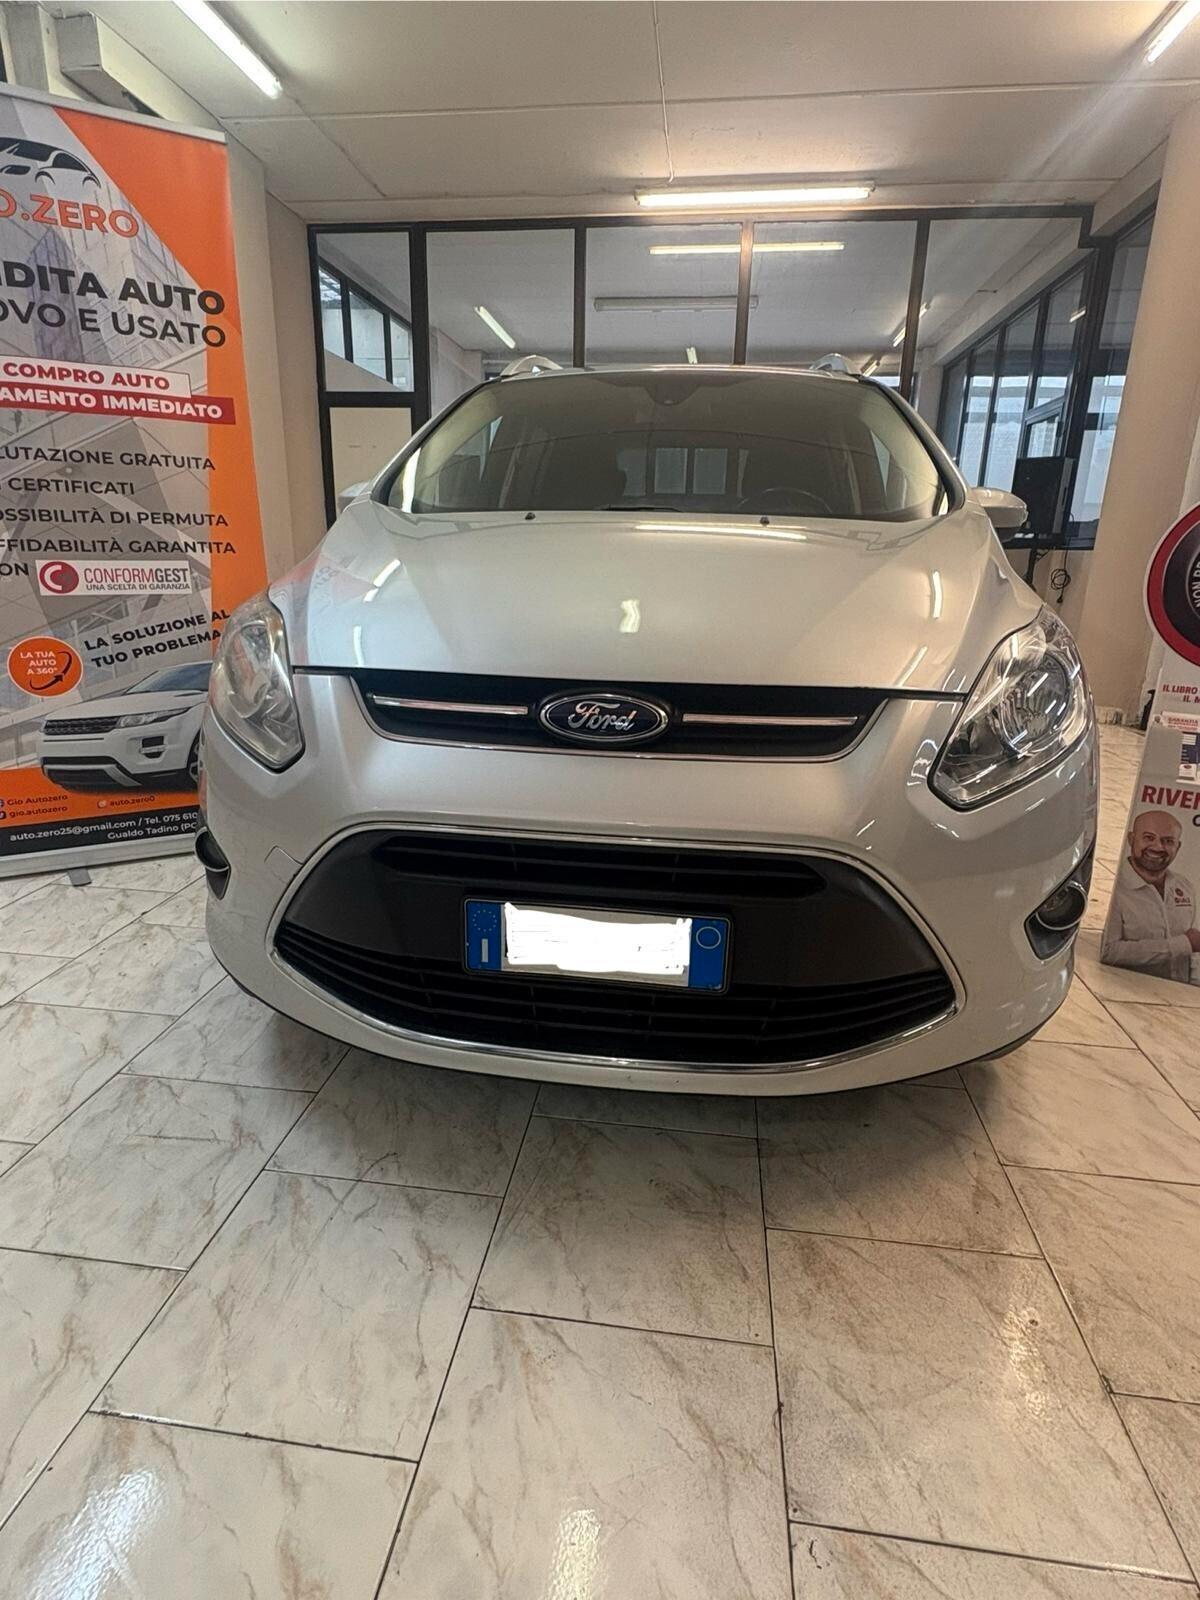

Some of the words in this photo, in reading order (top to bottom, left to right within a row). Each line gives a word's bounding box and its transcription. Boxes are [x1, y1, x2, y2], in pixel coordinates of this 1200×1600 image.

[0, 261, 108, 299] DITA
[118, 278, 225, 315] AUTO
[79, 308, 100, 332] E
[112, 312, 226, 347] USATO
[3, 362, 104, 384] COMPRO
[111, 372, 170, 390] AUTO
[0, 386, 96, 408] AMENTO
[103, 395, 223, 419] IMMEDIATO
[120, 452, 216, 470] GRATUITA
[8, 477, 135, 495] CERTIFICATI
[111, 511, 130, 524] DI
[138, 512, 229, 527] PERMUTA
[128, 540, 236, 554] GARANTITA
[83, 568, 188, 583] CONFORMGEST
[86, 583, 106, 591] UNA
[84, 637, 109, 651] LA
[111, 614, 207, 645] SOLUZIONE
[211, 609, 230, 622] AL
[91, 652, 128, 668] TUO
[132, 630, 221, 660] PROBLEMA
[29, 659, 57, 667] AUTO
[1162, 684, 1171, 692] IL
[1172, 685, 1198, 695] LIBRO
[568, 700, 637, 731] Ford
[25, 794, 68, 804] Autozero
[9, 806, 68, 818] gio.autozero
[10, 820, 136, 841] auto.zero25@gmail.com
[144, 816, 161, 824] Tel.
[163, 814, 181, 822] 075
[107, 831, 144, 839] Gualdo
[146, 826, 179, 835] Tadino
